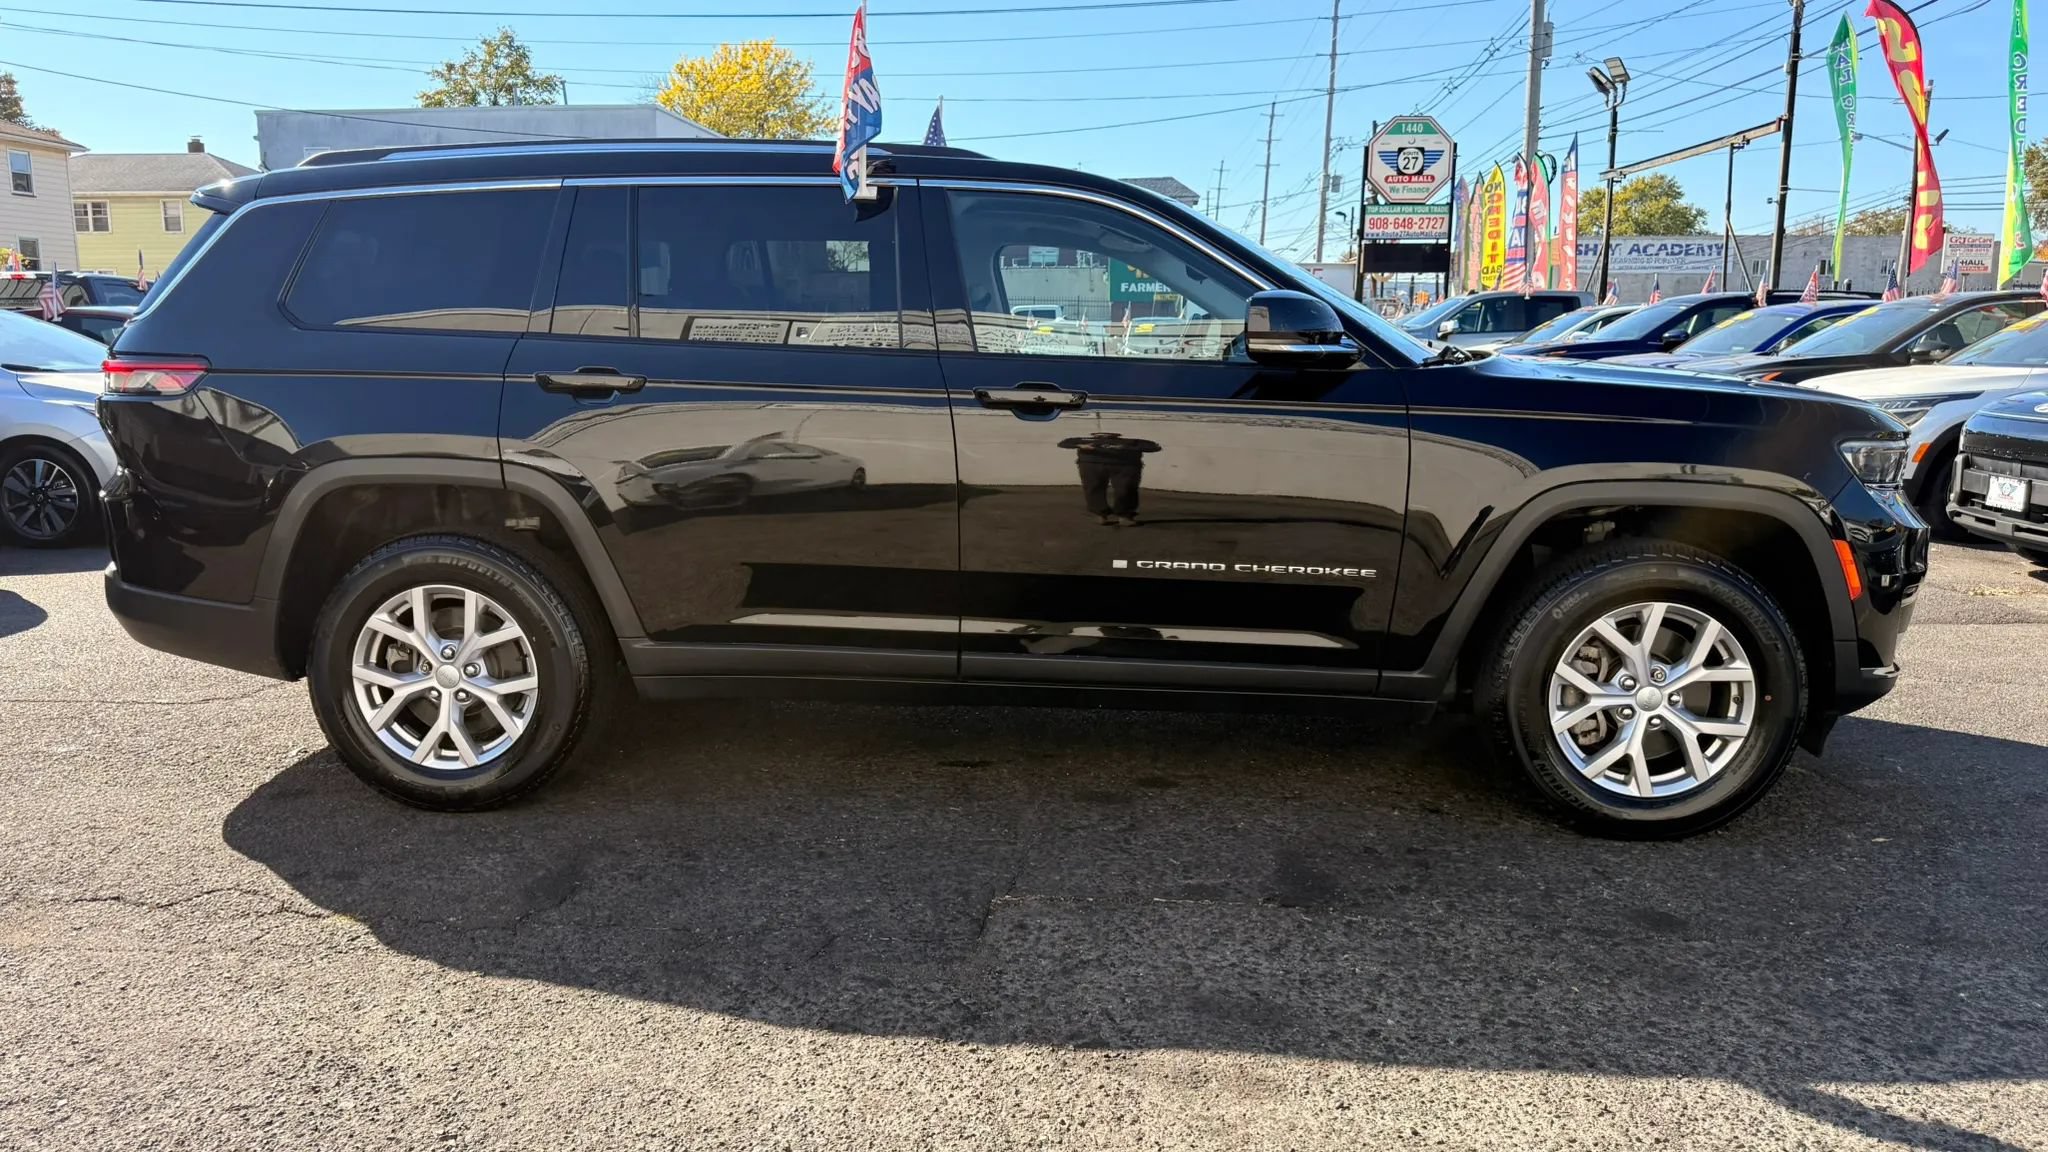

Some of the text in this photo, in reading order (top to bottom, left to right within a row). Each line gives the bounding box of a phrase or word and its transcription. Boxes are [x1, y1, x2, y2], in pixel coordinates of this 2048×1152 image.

[1401, 123, 1424, 133] 1440
[1402, 156, 1419, 170] 27
[1411, 175, 1433, 183] MALL
[1389, 186, 1431, 194] We Finance
[1379, 205, 1401, 213] DOLLAR
[1368, 217, 1446, 230] 908-648-2727
[1628, 243, 1725, 256] ACADEMY
[1136, 560, 1377, 578] GRAND CHEROKEE
